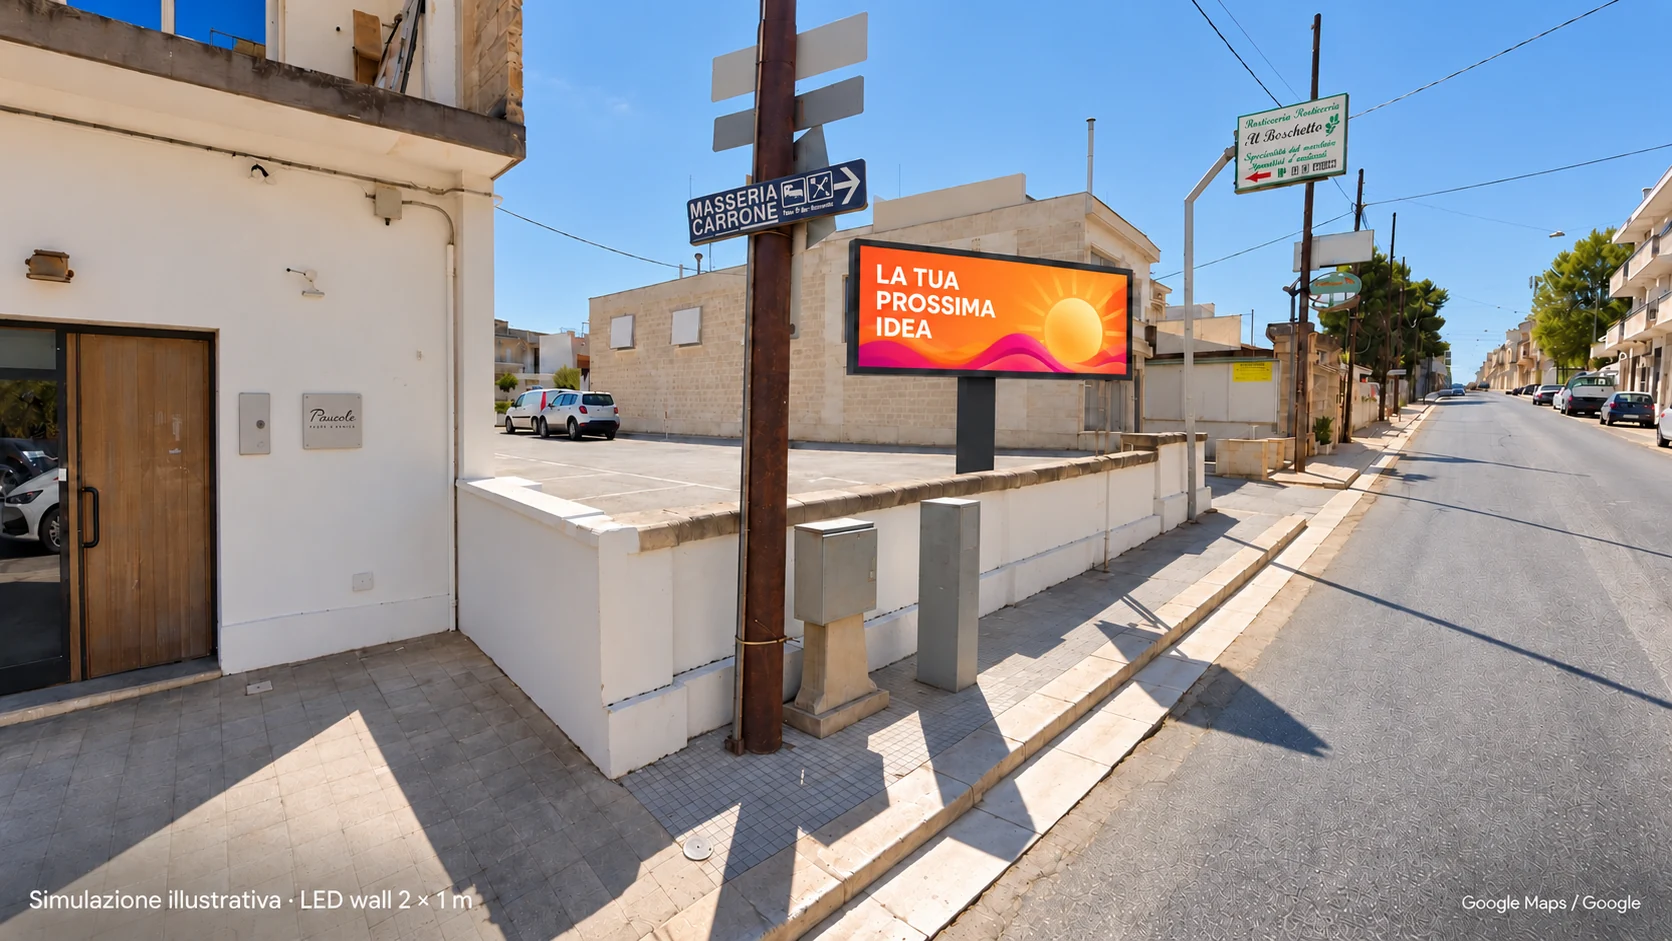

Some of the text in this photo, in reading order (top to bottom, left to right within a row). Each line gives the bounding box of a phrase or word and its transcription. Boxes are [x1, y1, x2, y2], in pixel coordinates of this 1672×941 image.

[1263, 121, 1322, 142] Boschetto
[690, 184, 778, 220] MASSERIA
[692, 201, 779, 236] CARRONE
[876, 264, 960, 290] LA TUA
[876, 290, 996, 318] PROSSIMA
[876, 317, 932, 339] IDEA
[309, 408, 356, 422] Paucole
